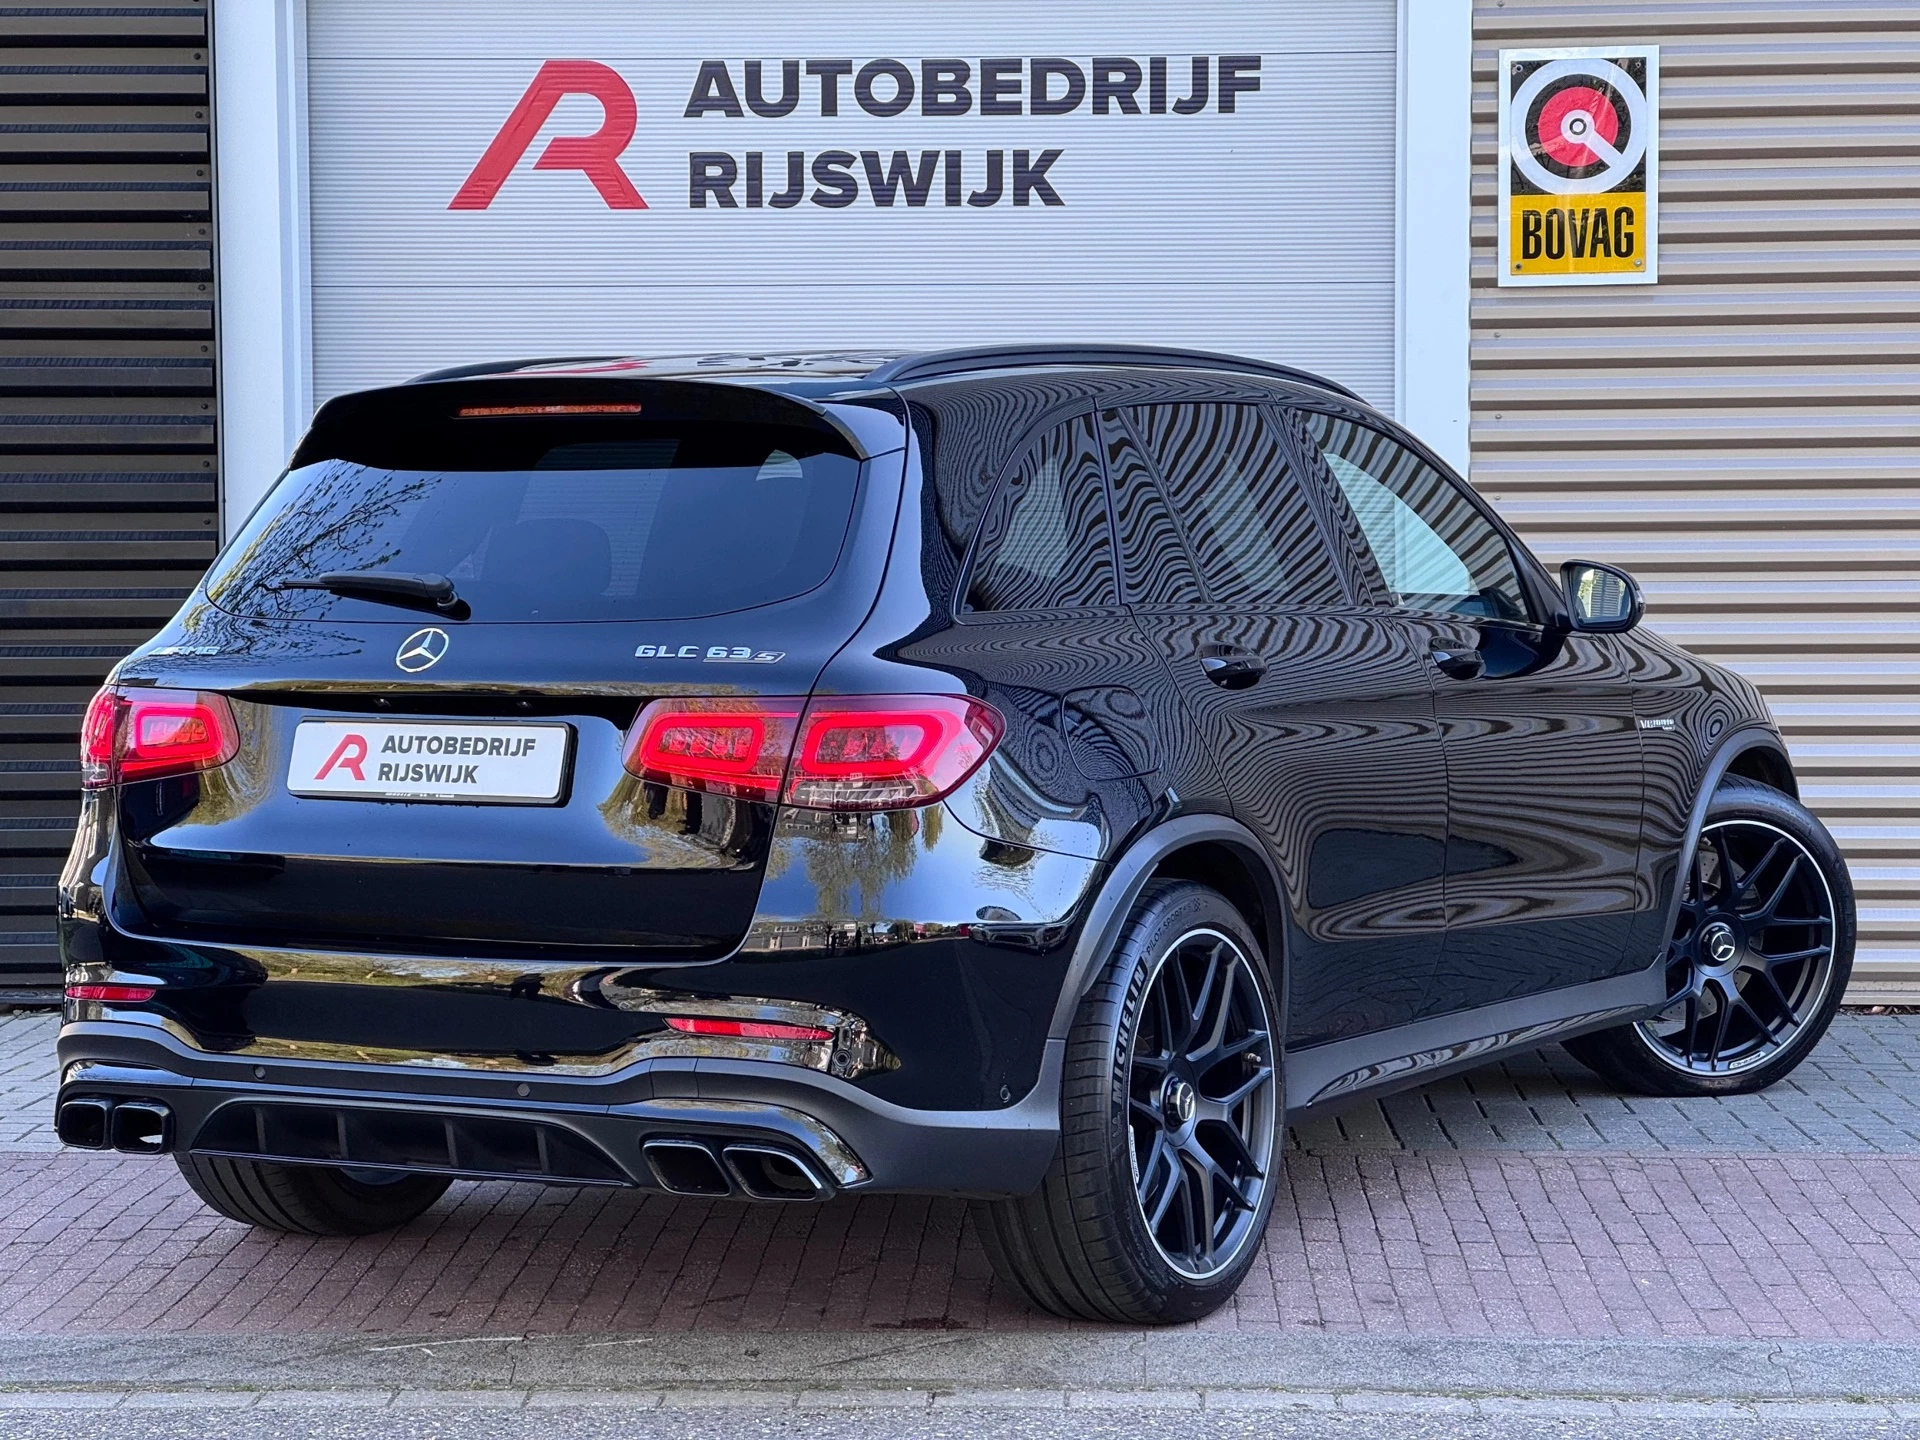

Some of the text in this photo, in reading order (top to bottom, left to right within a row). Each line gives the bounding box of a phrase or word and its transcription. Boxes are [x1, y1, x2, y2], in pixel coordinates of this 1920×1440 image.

[683, 54, 1262, 118] AUTOBEDRIJF
[689, 149, 1064, 209] RIJSWIJK
[1521, 206, 1634, 260] BOVAG
[634, 645, 699, 658] GLC
[706, 646, 751, 659] 63
[381, 735, 536, 757] AUTOBEDRIJF
[377, 763, 479, 784] RIJSWIJK
[1146, 927, 1164, 956] PILOT
[1163, 907, 1183, 929] SPORT
[1112, 966, 1145, 1105] MICHELIN
